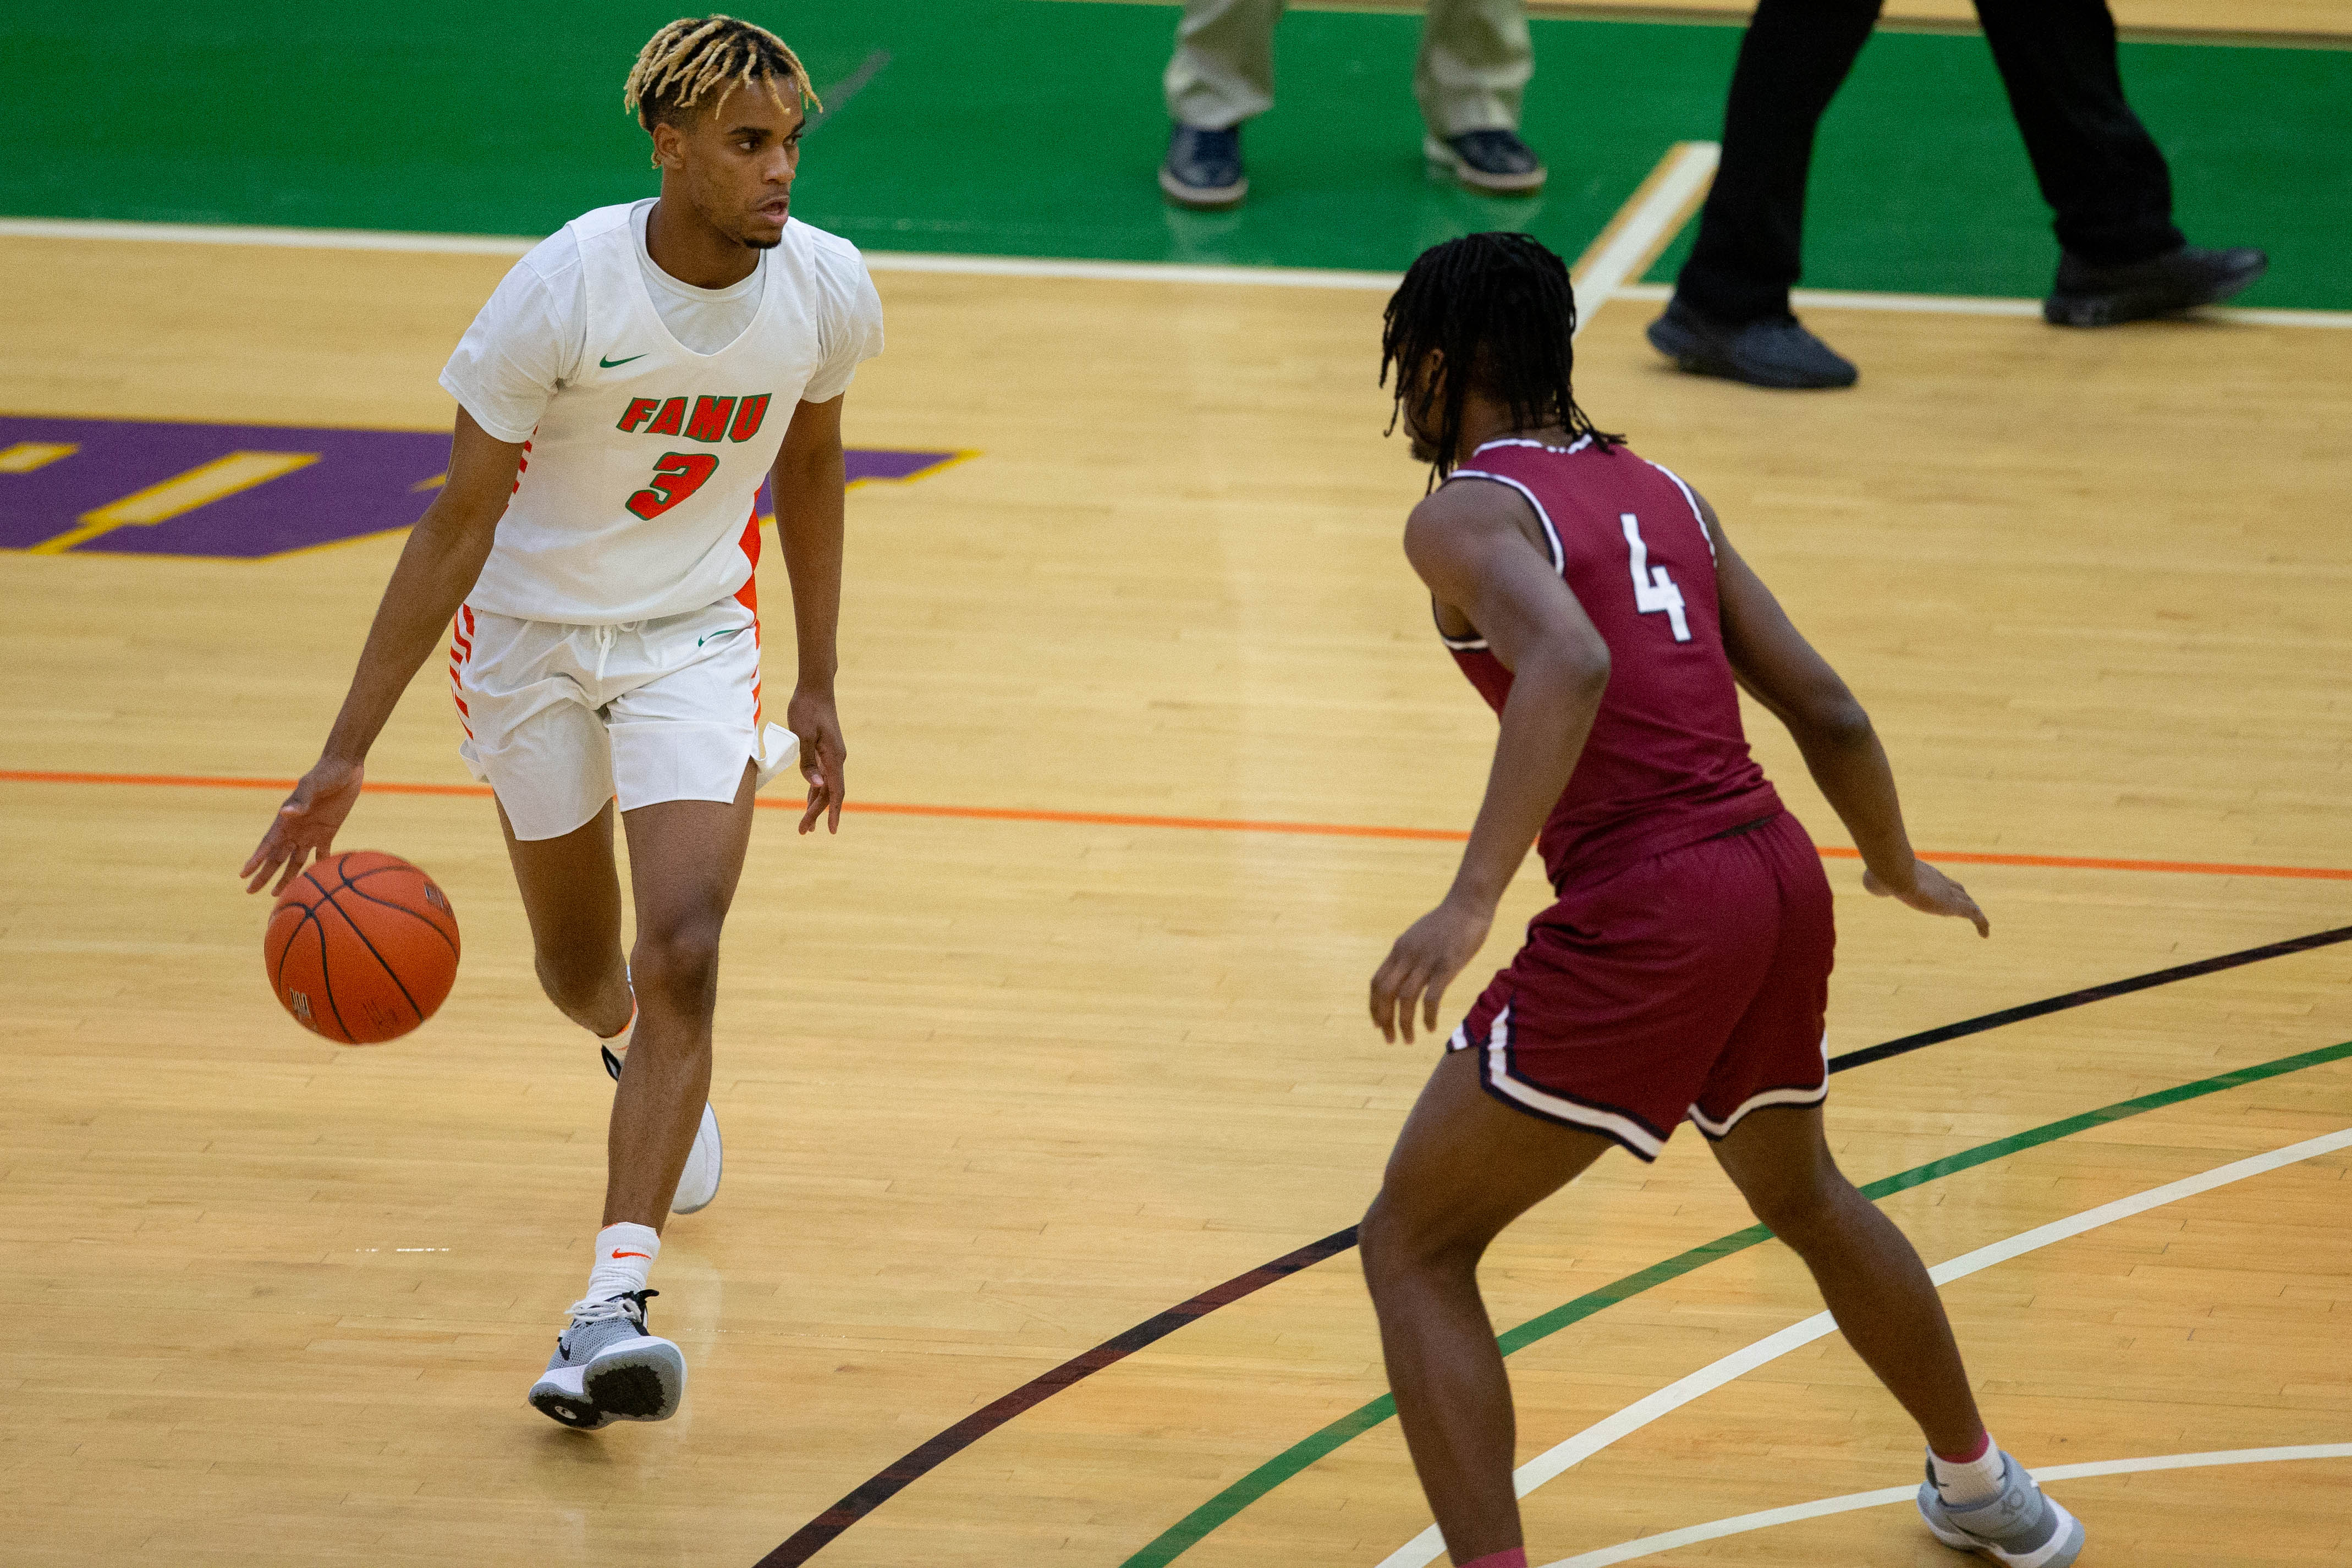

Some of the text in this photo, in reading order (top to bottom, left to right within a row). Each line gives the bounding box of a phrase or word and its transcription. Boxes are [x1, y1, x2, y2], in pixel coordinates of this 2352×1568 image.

[616, 393, 772, 443] FAMU
[625, 452, 719, 521] 3
[1620, 513, 1692, 642] 4
